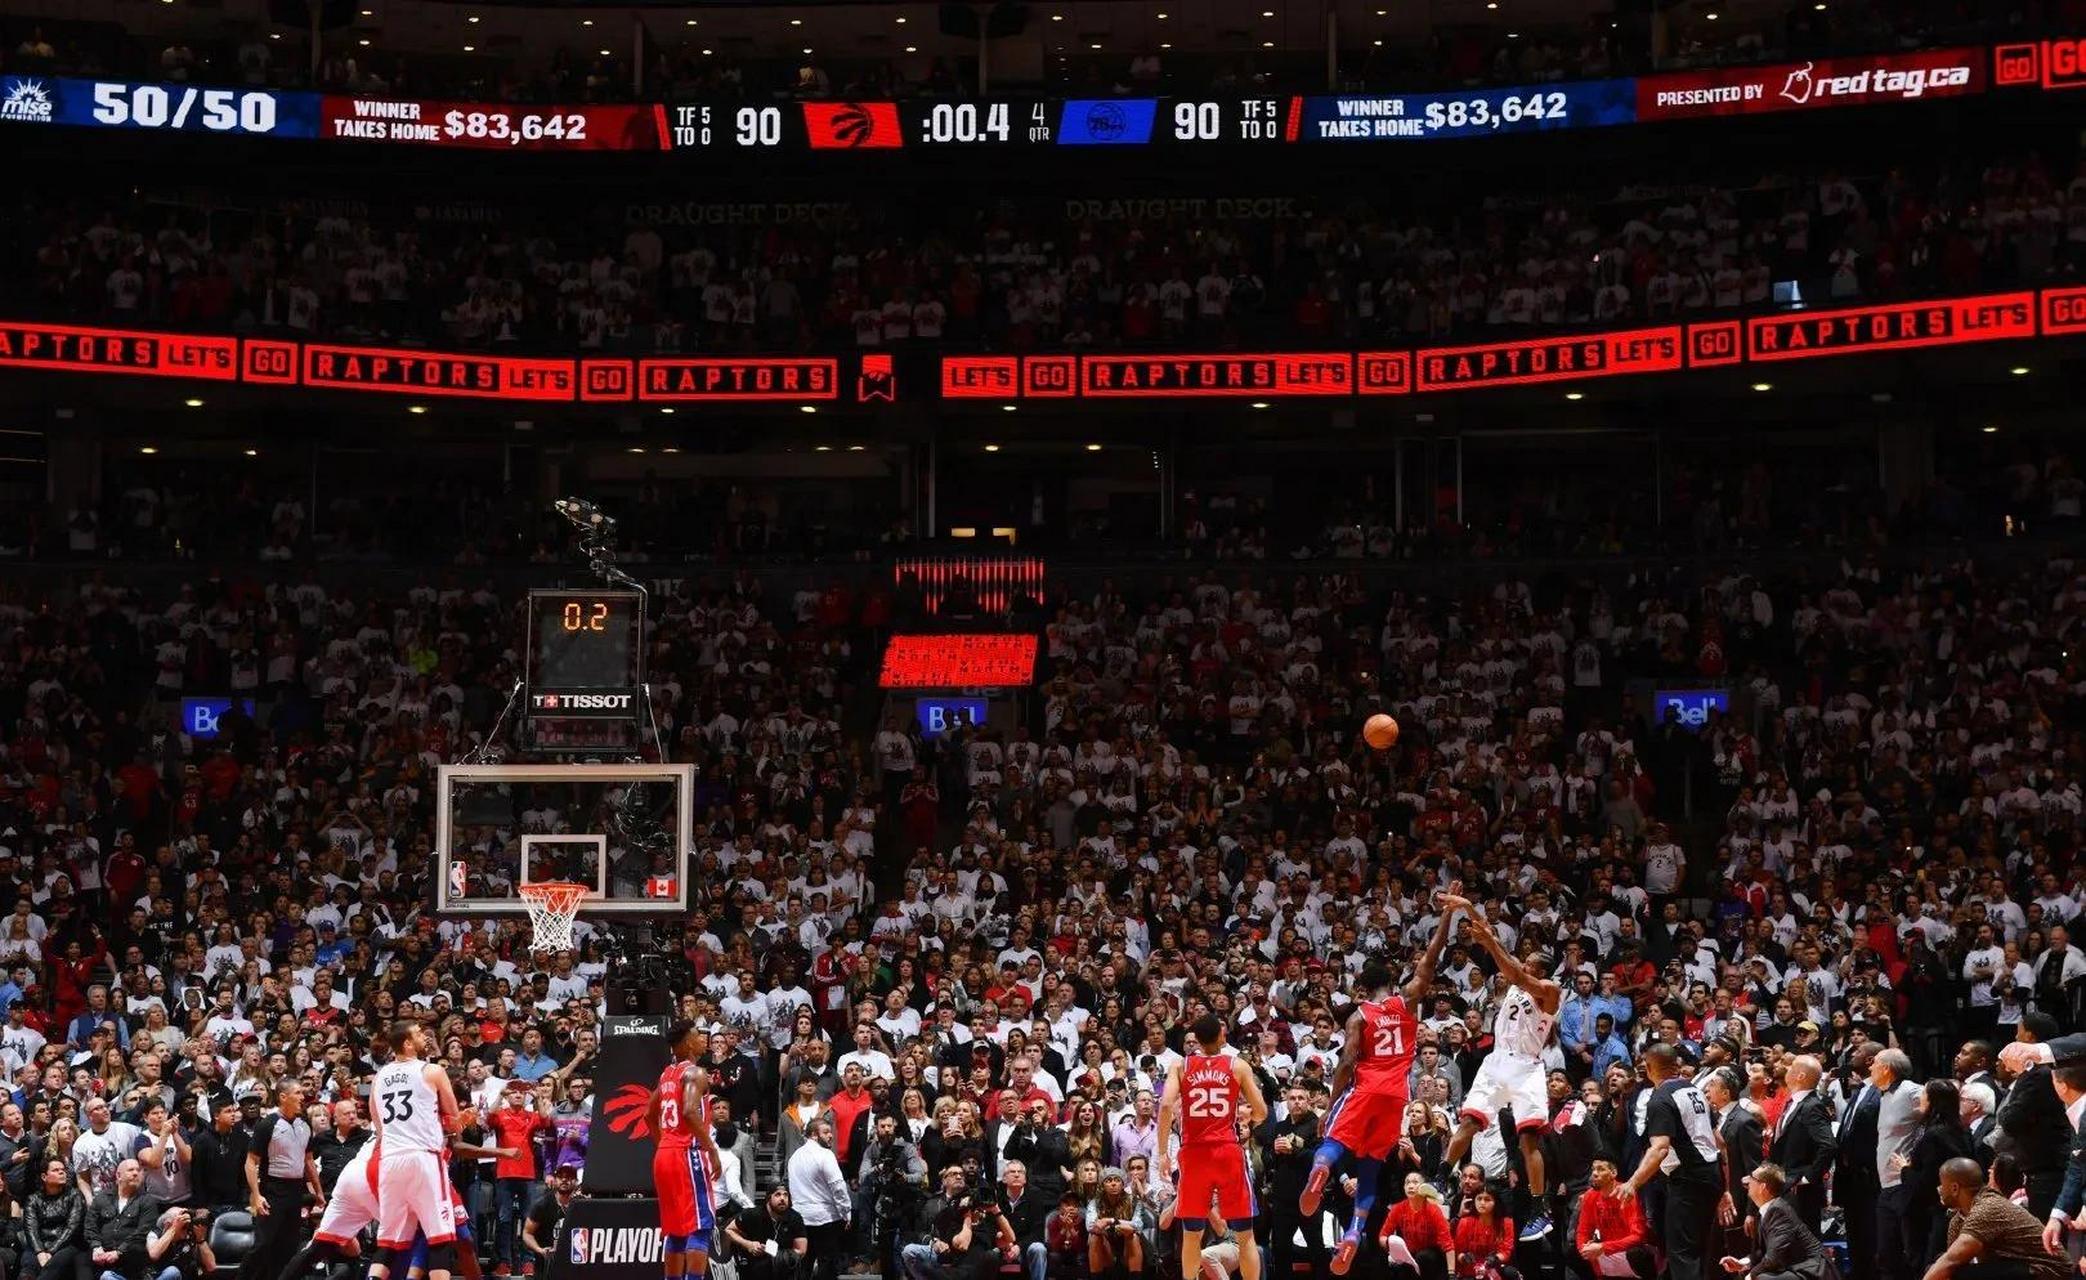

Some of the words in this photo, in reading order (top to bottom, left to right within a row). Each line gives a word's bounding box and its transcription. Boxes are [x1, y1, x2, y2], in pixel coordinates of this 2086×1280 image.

[2003, 57, 2030, 79] GO
[2, 97, 52, 115] mlse
[1657, 87, 1741, 106] PRESENTED
[1745, 84, 1764, 100] BY
[93, 83, 276, 132] 50/50
[353, 100, 421, 120] WINNER
[677, 107, 695, 126] TF
[701, 106, 711, 125] 5
[1032, 102, 1045, 126] 4
[1242, 101, 1260, 118] TF
[1266, 100, 1276, 118] 5
[1337, 100, 1404, 116] WINNER
[1425, 92, 1567, 130] $83,642
[334, 119, 387, 139] TAKES
[391, 123, 441, 141] HOME
[444, 110, 587, 145] $83,642
[736, 107, 781, 146] 90
[923, 103, 1010, 143] :00.4
[1174, 102, 1220, 140] 90
[1240, 121, 1260, 138] TO
[1266, 121, 1276, 138] 0
[1319, 120, 1371, 137] TAKES
[1374, 118, 1424, 136] HOME
[674, 127, 695, 145] TO
[701, 127, 711, 145] 0
[1029, 127, 1049, 143] QTR
[951, 366, 1011, 387] LET'S
[1035, 366, 1065, 387] GO
[1096, 363, 1269, 387] RAPTORS
[1285, 362, 1346, 384] LET'S
[1369, 362, 1399, 383] GO
[1429, 344, 1600, 381] RAPTORS
[1615, 337, 1674, 362] LET'S
[1700, 332, 1730, 354] GO
[1761, 310, 1946, 350] RAPTORS
[1963, 303, 2029, 329] LET'S
[2054, 298, 2086, 321] GO
[169, 343, 230, 368] LET'S
[255, 349, 287, 372] GO
[318, 354, 494, 388] RAPTORS
[509, 367, 569, 390] LET'S
[592, 369, 622, 390] GO
[653, 367, 825, 391] RAPTORS
[565, 603, 608, 631] 0.2
[559, 695, 631, 708] TISSOT
[1509, 1004, 1519, 1021] 2
[614, 1025, 659, 1035] SPALDING
[1373, 1027, 1404, 1056] 21
[1186, 1070, 1230, 1086] SIMMONS
[382, 1090, 413, 1124] 33
[1189, 1087, 1230, 1117] 25
[590, 1227, 665, 1263] PLAYOF
